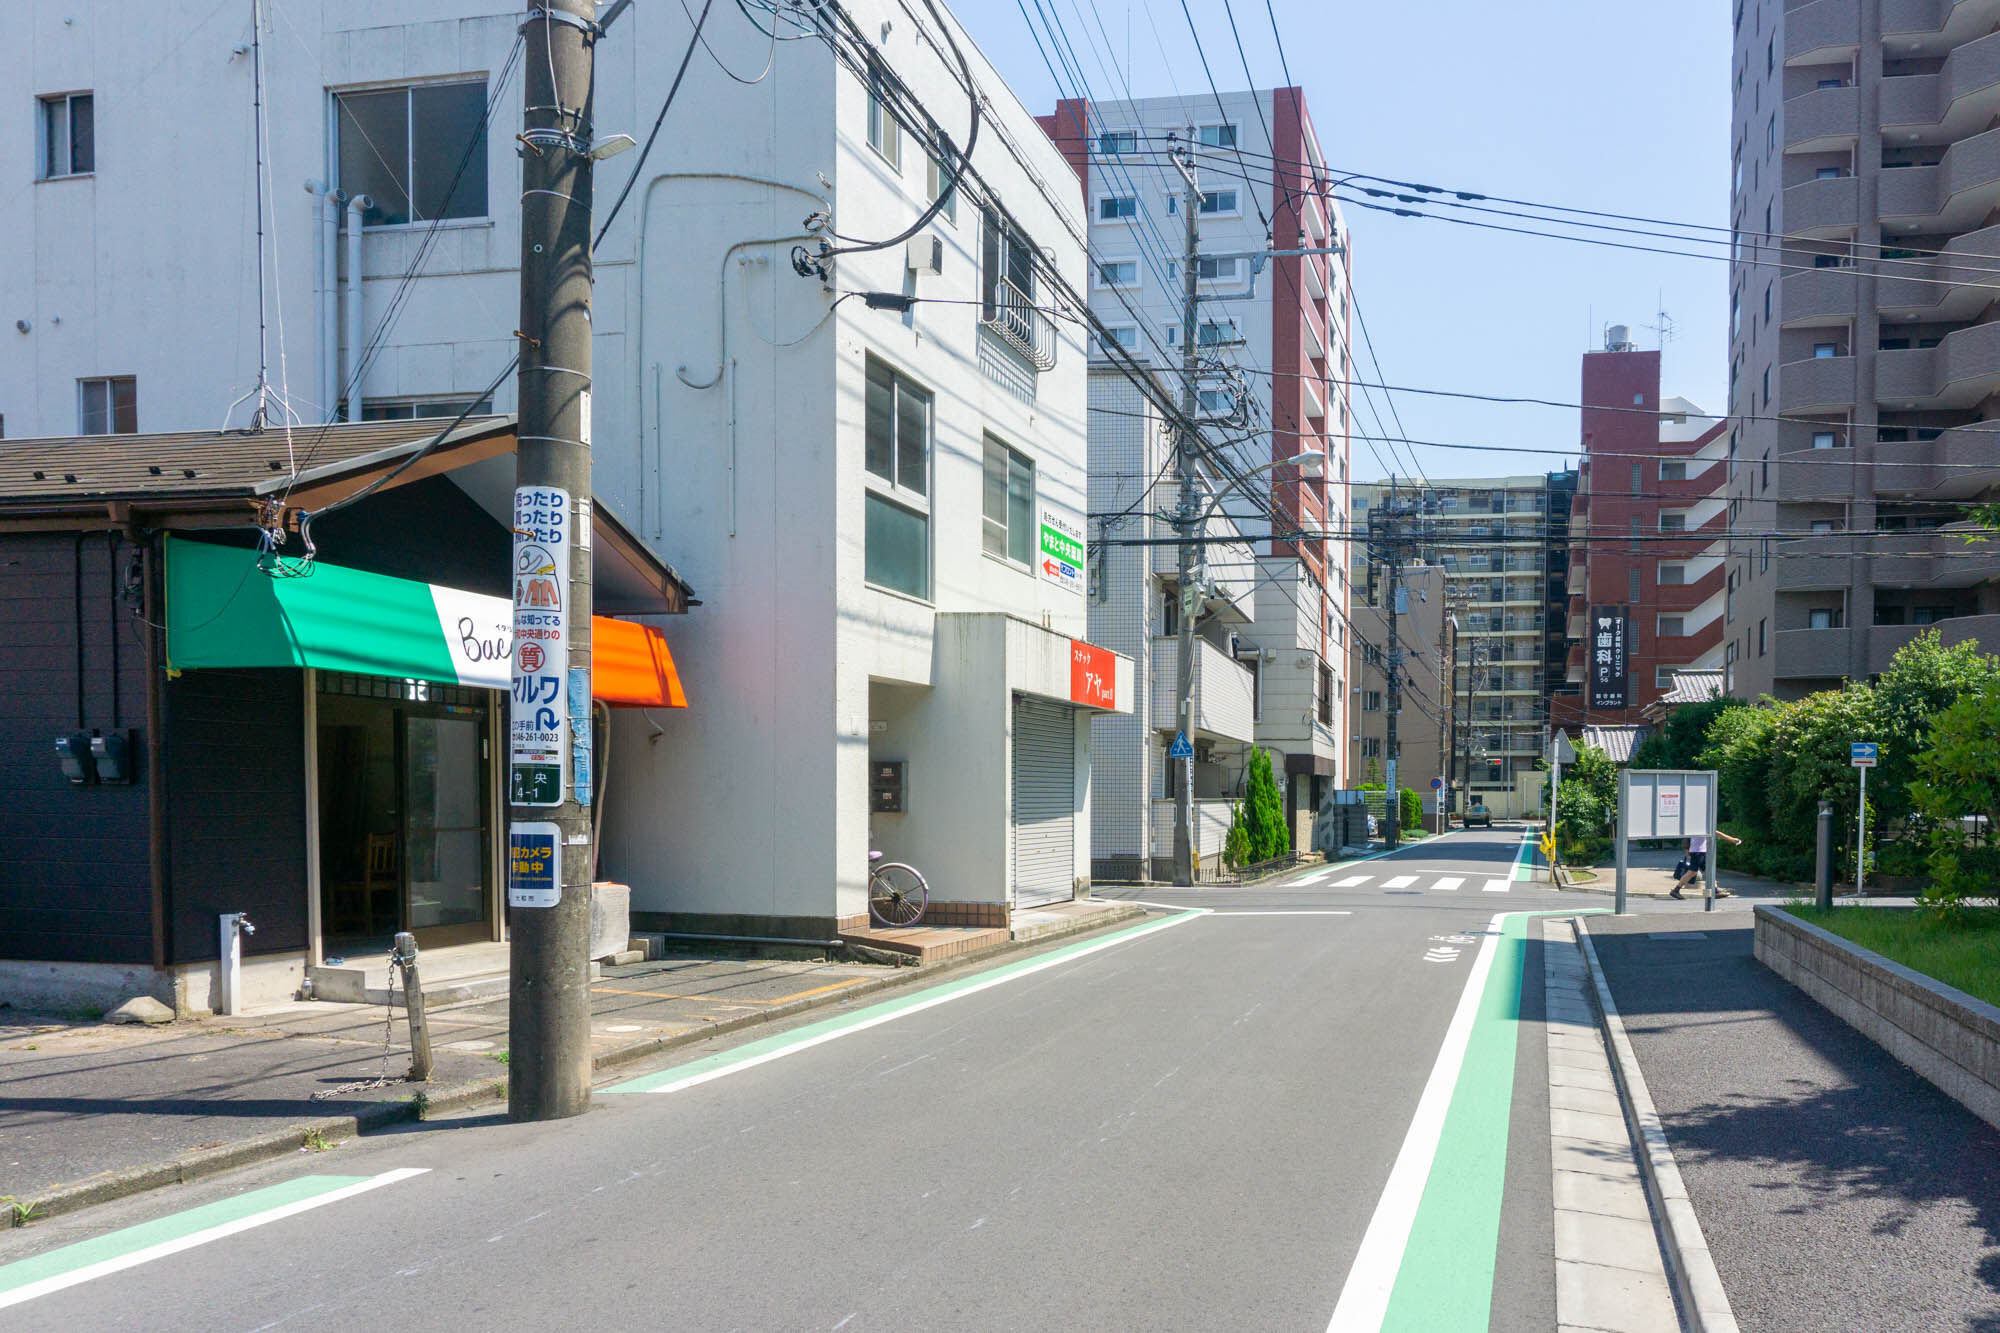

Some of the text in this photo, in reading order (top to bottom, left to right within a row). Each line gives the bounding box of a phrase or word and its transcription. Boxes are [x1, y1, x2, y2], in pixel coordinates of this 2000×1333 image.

[458, 616, 513, 663] Bac
[1596, 631, 1613, 665] 歯科
[520, 646, 541, 670] 質
[1074, 649, 1091, 665] スナック
[512, 674, 560, 705] マルワ
[1085, 671, 1102, 697] アヤ
[514, 771, 548, 785] 中央
[517, 787, 539, 799] 4-1
